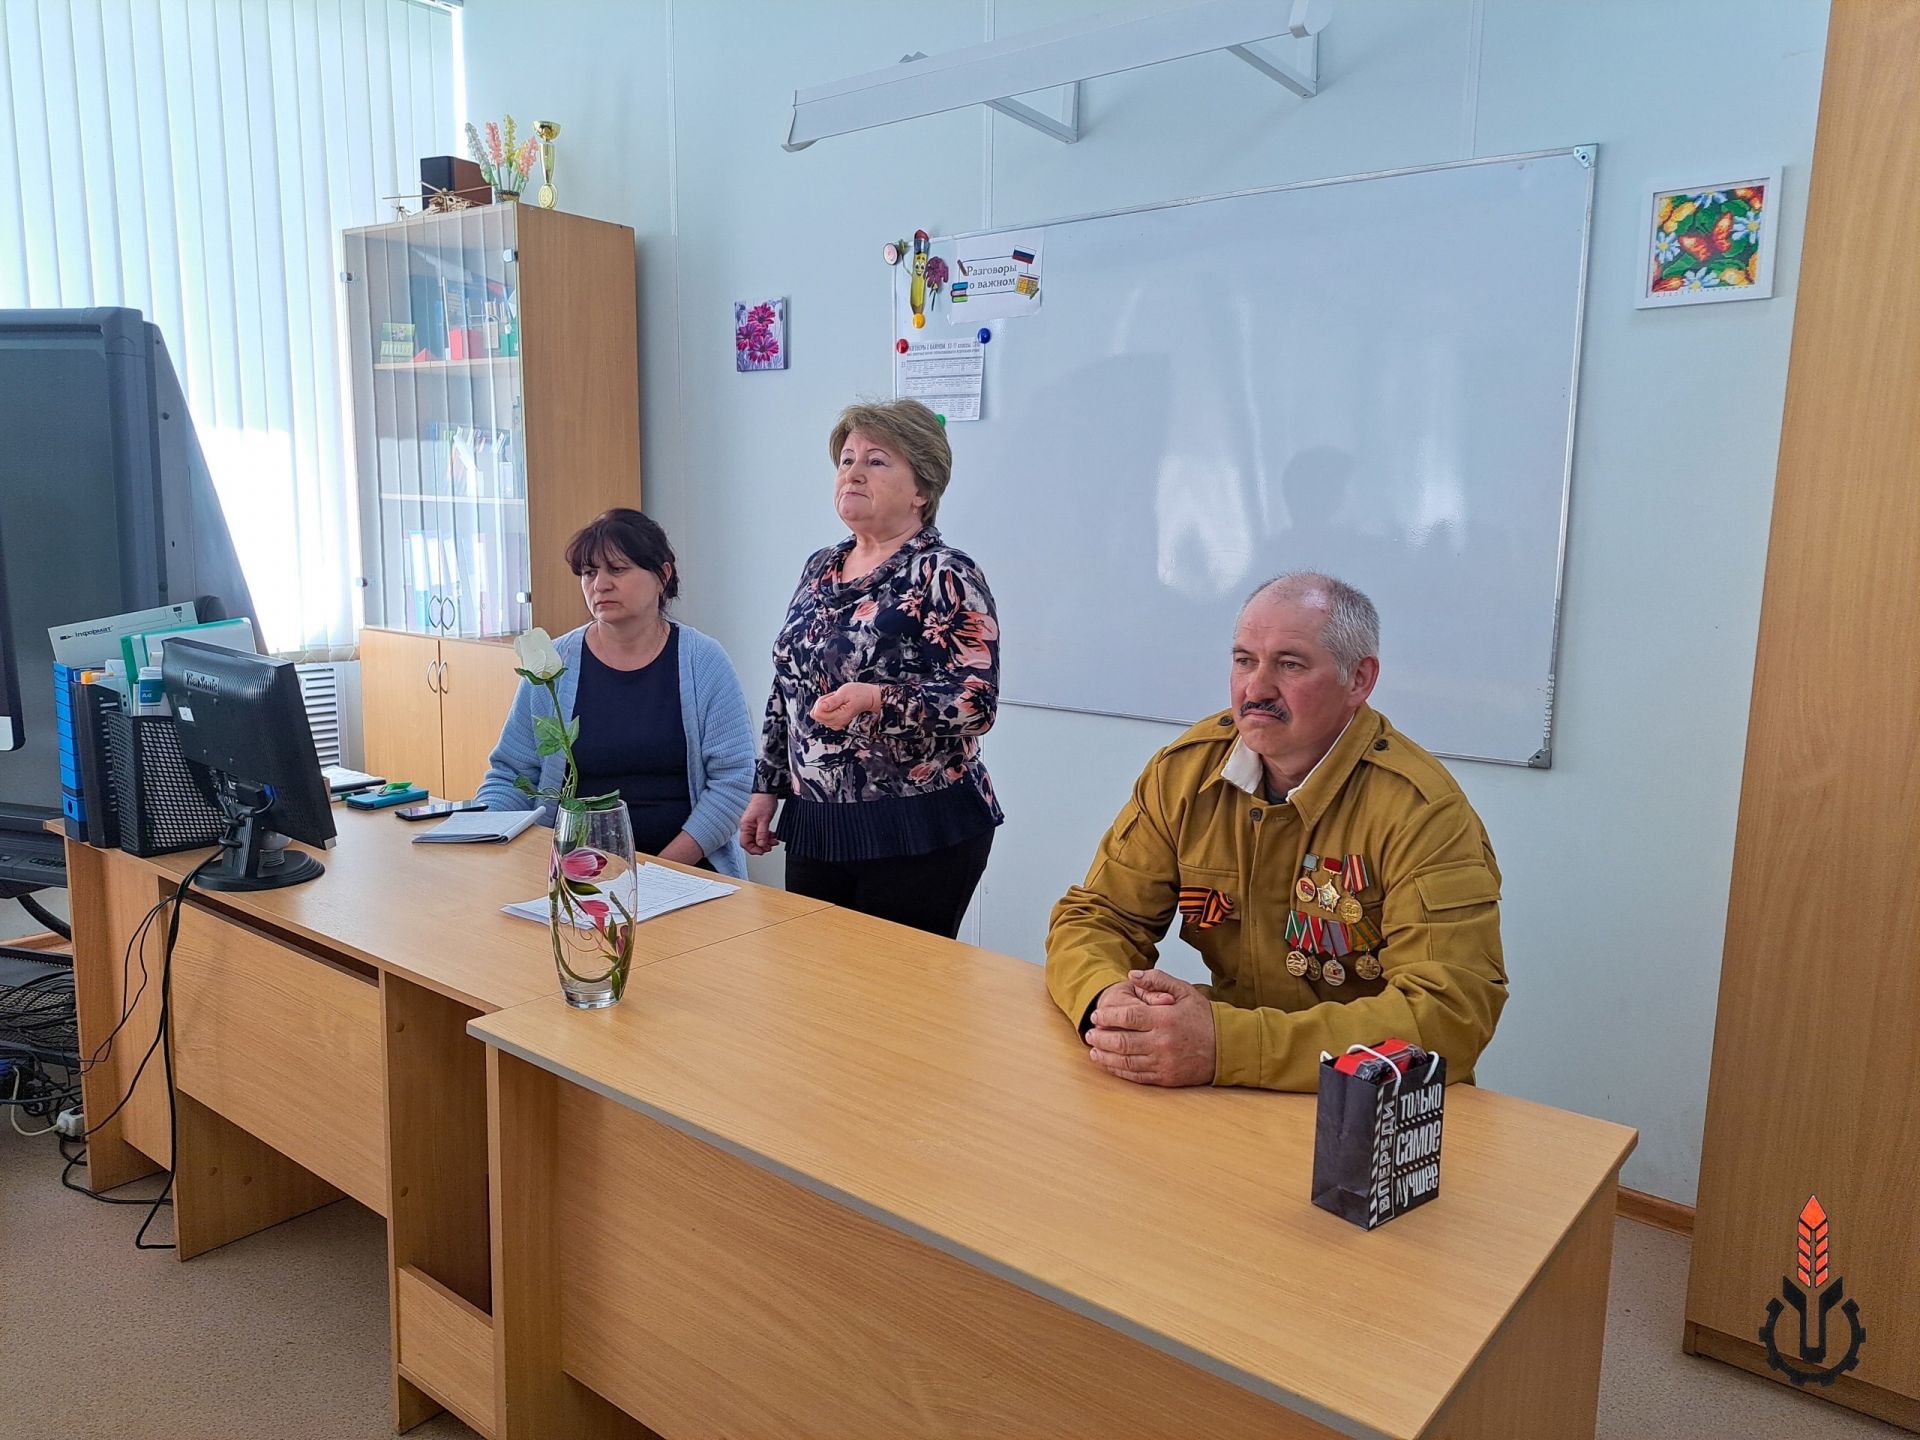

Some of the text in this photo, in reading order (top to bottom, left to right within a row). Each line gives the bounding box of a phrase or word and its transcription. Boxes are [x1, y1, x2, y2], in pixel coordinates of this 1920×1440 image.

[967, 264, 1017, 276] Разговоры
[977, 278, 1016, 289] важном
[1377, 1100, 1396, 1214] ВПЕРЕДИ
